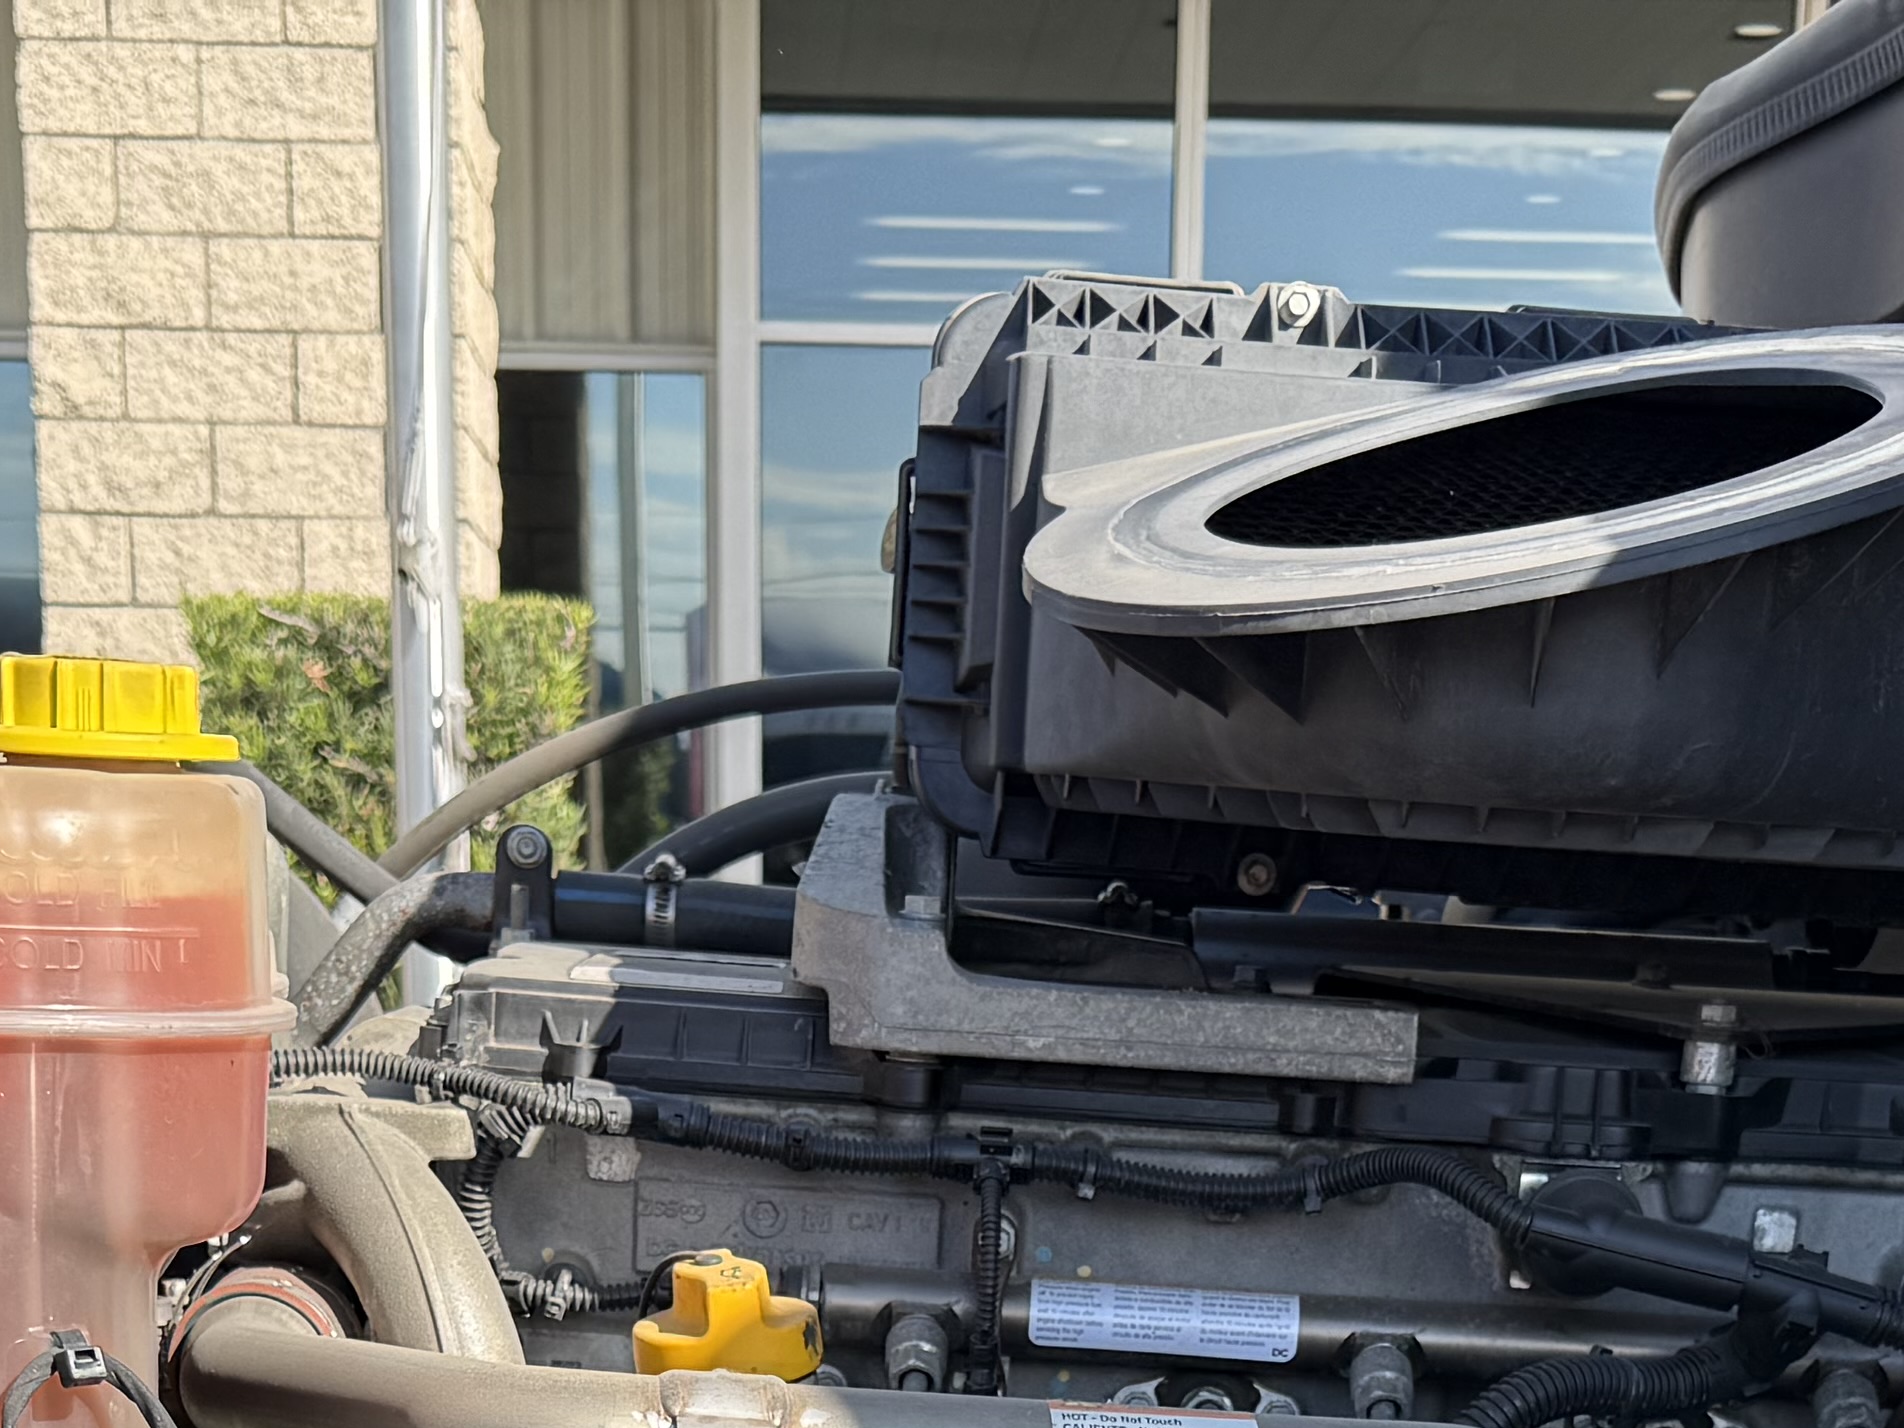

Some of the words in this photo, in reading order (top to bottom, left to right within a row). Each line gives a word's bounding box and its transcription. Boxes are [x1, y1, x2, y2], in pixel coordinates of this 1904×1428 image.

[1271, 1347, 1289, 1358] DC
[1062, 1413, 1088, 1422] HOT
[1100, 1414, 1118, 1424] Do
[1146, 1416, 1182, 1427] Touch
